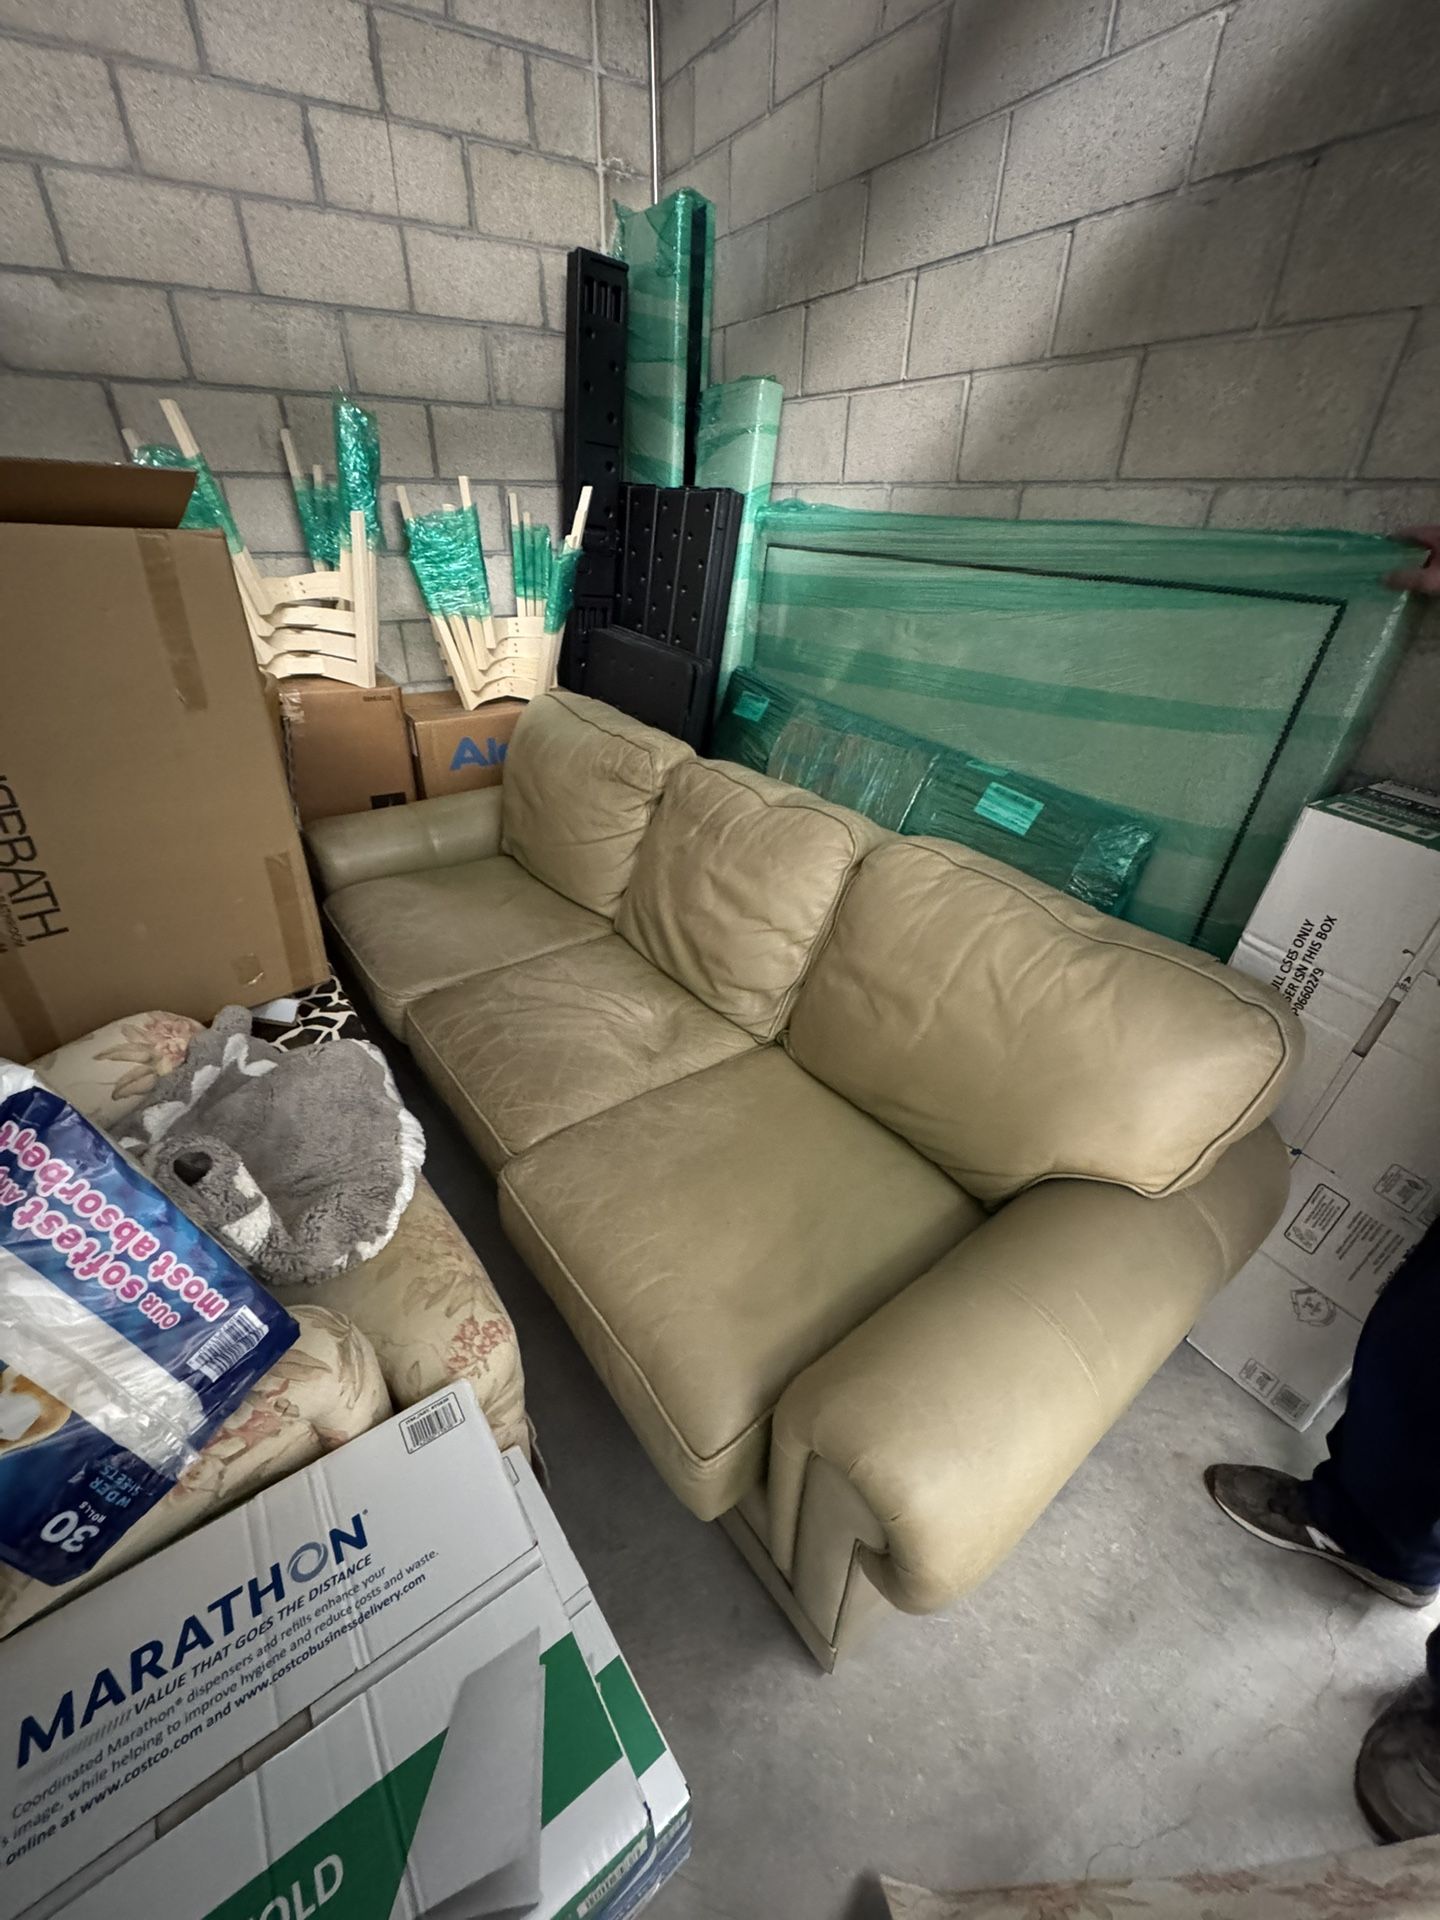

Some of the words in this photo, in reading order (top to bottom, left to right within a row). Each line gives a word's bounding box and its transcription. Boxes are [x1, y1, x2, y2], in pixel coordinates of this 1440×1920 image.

[1293, 918, 1316, 948] ONLY
[1302, 940, 1323, 965] THIS
[1315, 914, 1338, 941] BOX
[0, 1120, 161, 1261] absorbent
[12, 1196, 148, 1302] softest
[147, 1251, 229, 1322] most
[138, 1292, 181, 1329] OUR
[40, 1510, 100, 1553] 30
[79, 1501, 108, 1523] ROLLS
[17, 1513, 368, 1769] MARATHON
[68, 1765, 108, 1802] while
[111, 1731, 163, 1774] helping
[166, 1720, 181, 1736] to
[184, 1681, 238, 1723] improve
[239, 1647, 287, 1685] hygiene
[289, 1630, 312, 1652] and
[314, 1605, 353, 1634] reduce
[354, 1586, 382, 1610] costs
[383, 1569, 404, 1590] and
[404, 1549, 439, 1575] waste.
[134, 1672, 187, 1714] VALUE
[191, 1643, 231, 1678] THAT
[235, 1616, 274, 1649] GOES
[278, 1595, 306, 1621] THE
[308, 1554, 372, 1602] DISTANCE
[6, 1823, 57, 1866] online
[60, 1811, 76, 1827] at
[79, 1725, 203, 1814] www.costco.com
[206, 1704, 231, 1727] and
[234, 1573, 426, 1706] www.costcobusinessdelivery.com
[11, 1751, 104, 1819] Coordinated
[186, 1653, 254, 1703] dispensers
[256, 1634, 278, 1658] and
[280, 1609, 312, 1638] refills
[314, 1585, 360, 1618] enhance
[361, 1566, 386, 1590] your
